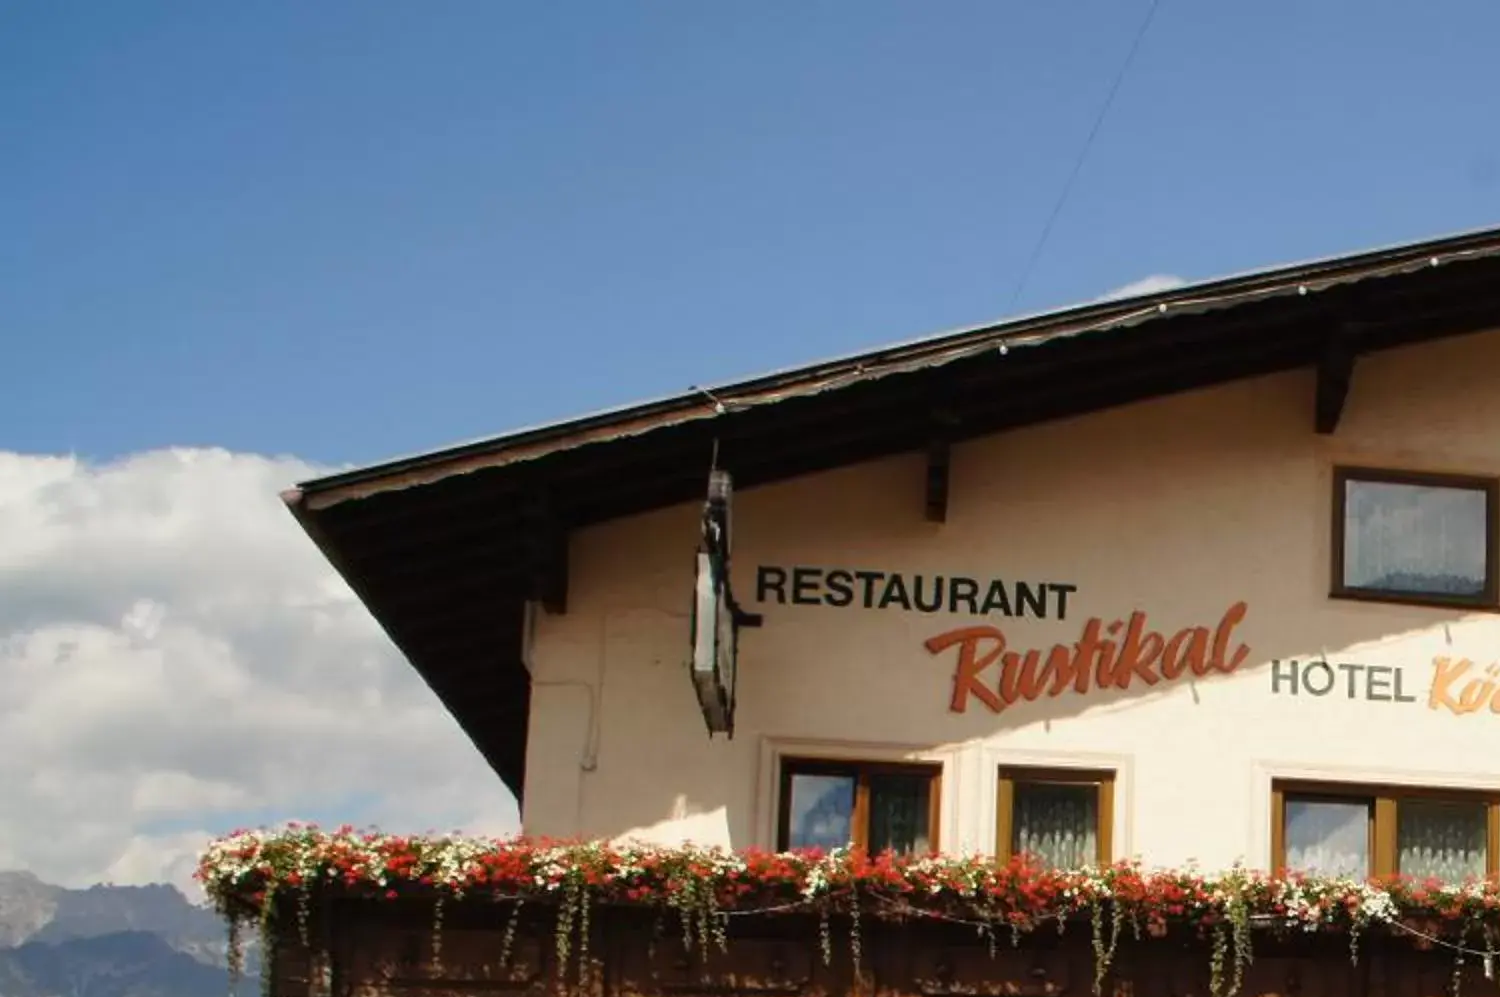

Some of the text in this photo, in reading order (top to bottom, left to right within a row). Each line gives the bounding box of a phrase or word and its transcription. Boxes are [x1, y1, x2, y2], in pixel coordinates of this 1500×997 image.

[757, 565, 1077, 620] RESTAURANT
[924, 601, 1250, 714] Rustikal
[1271, 659, 1416, 702] HOTEL
